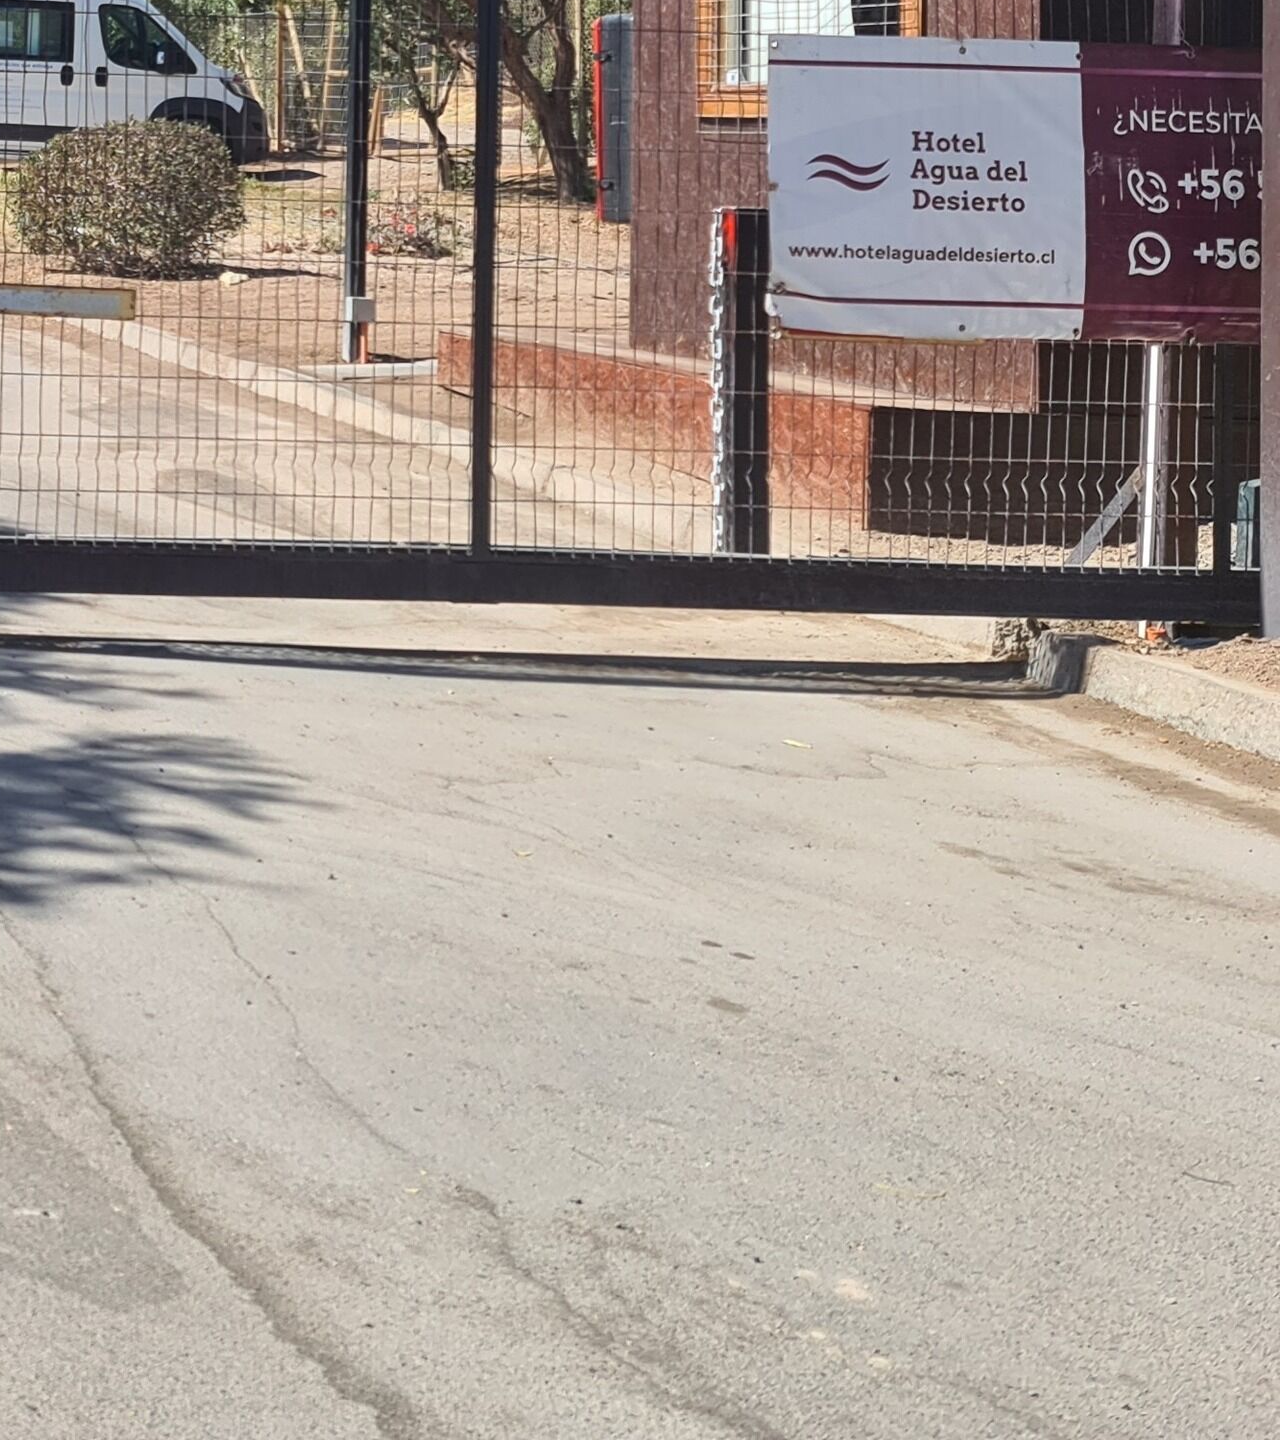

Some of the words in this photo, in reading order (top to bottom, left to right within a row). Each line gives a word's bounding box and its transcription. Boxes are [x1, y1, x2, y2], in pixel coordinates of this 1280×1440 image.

[1113, 109, 1263, 136] ¿NECESITA
[911, 131, 986, 154] Hotel
[910, 158, 980, 185] Agua
[986, 160, 1028, 182] del
[1177, 168, 1245, 201] +56
[912, 189, 1026, 213] Desierto
[788, 244, 1056, 265] www.hotelaguadeldesierto.cl
[1193, 238, 1261, 270] +56
